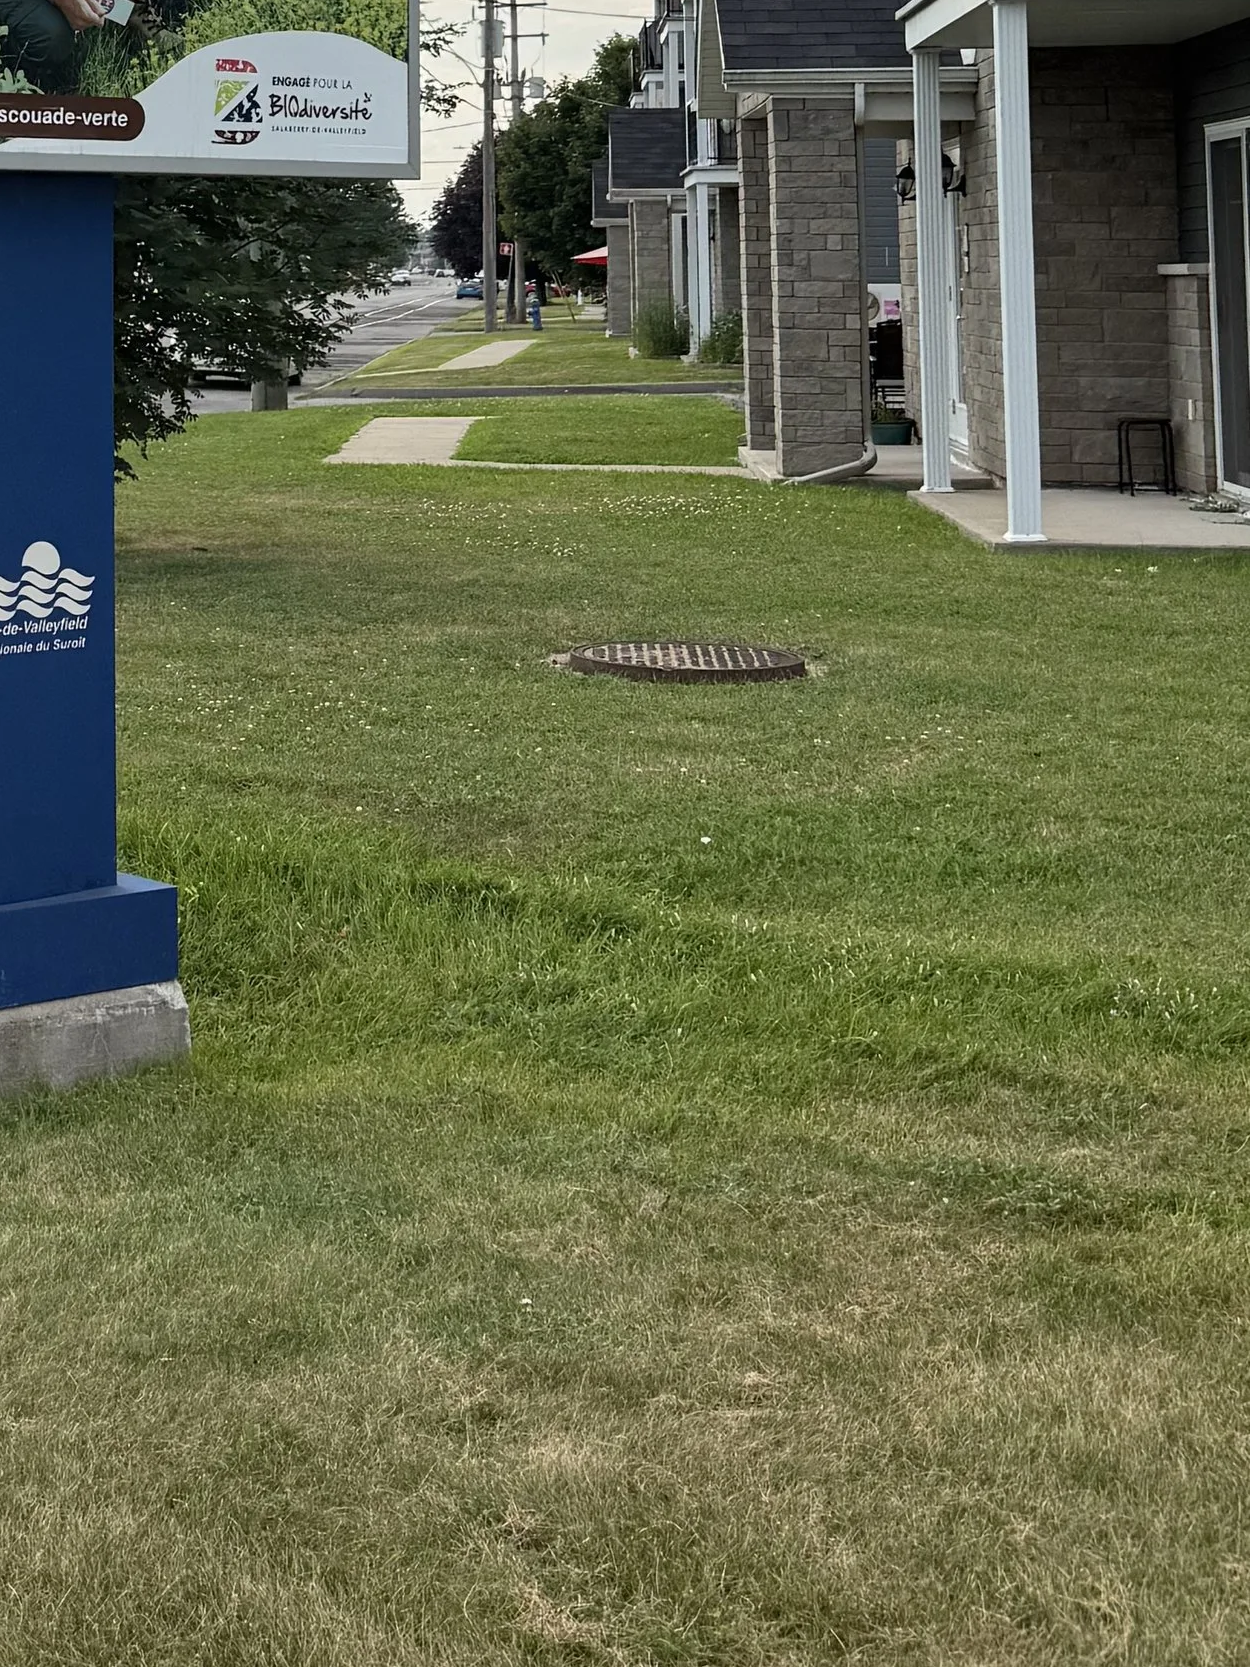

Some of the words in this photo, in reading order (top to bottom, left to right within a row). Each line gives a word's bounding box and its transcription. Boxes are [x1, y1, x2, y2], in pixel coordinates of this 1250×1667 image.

[272, 76, 310, 88] ENGAGÉ
[313, 78, 338, 89] POUR
[342, 80, 353, 90] LA
[35, 640, 50, 652] du
